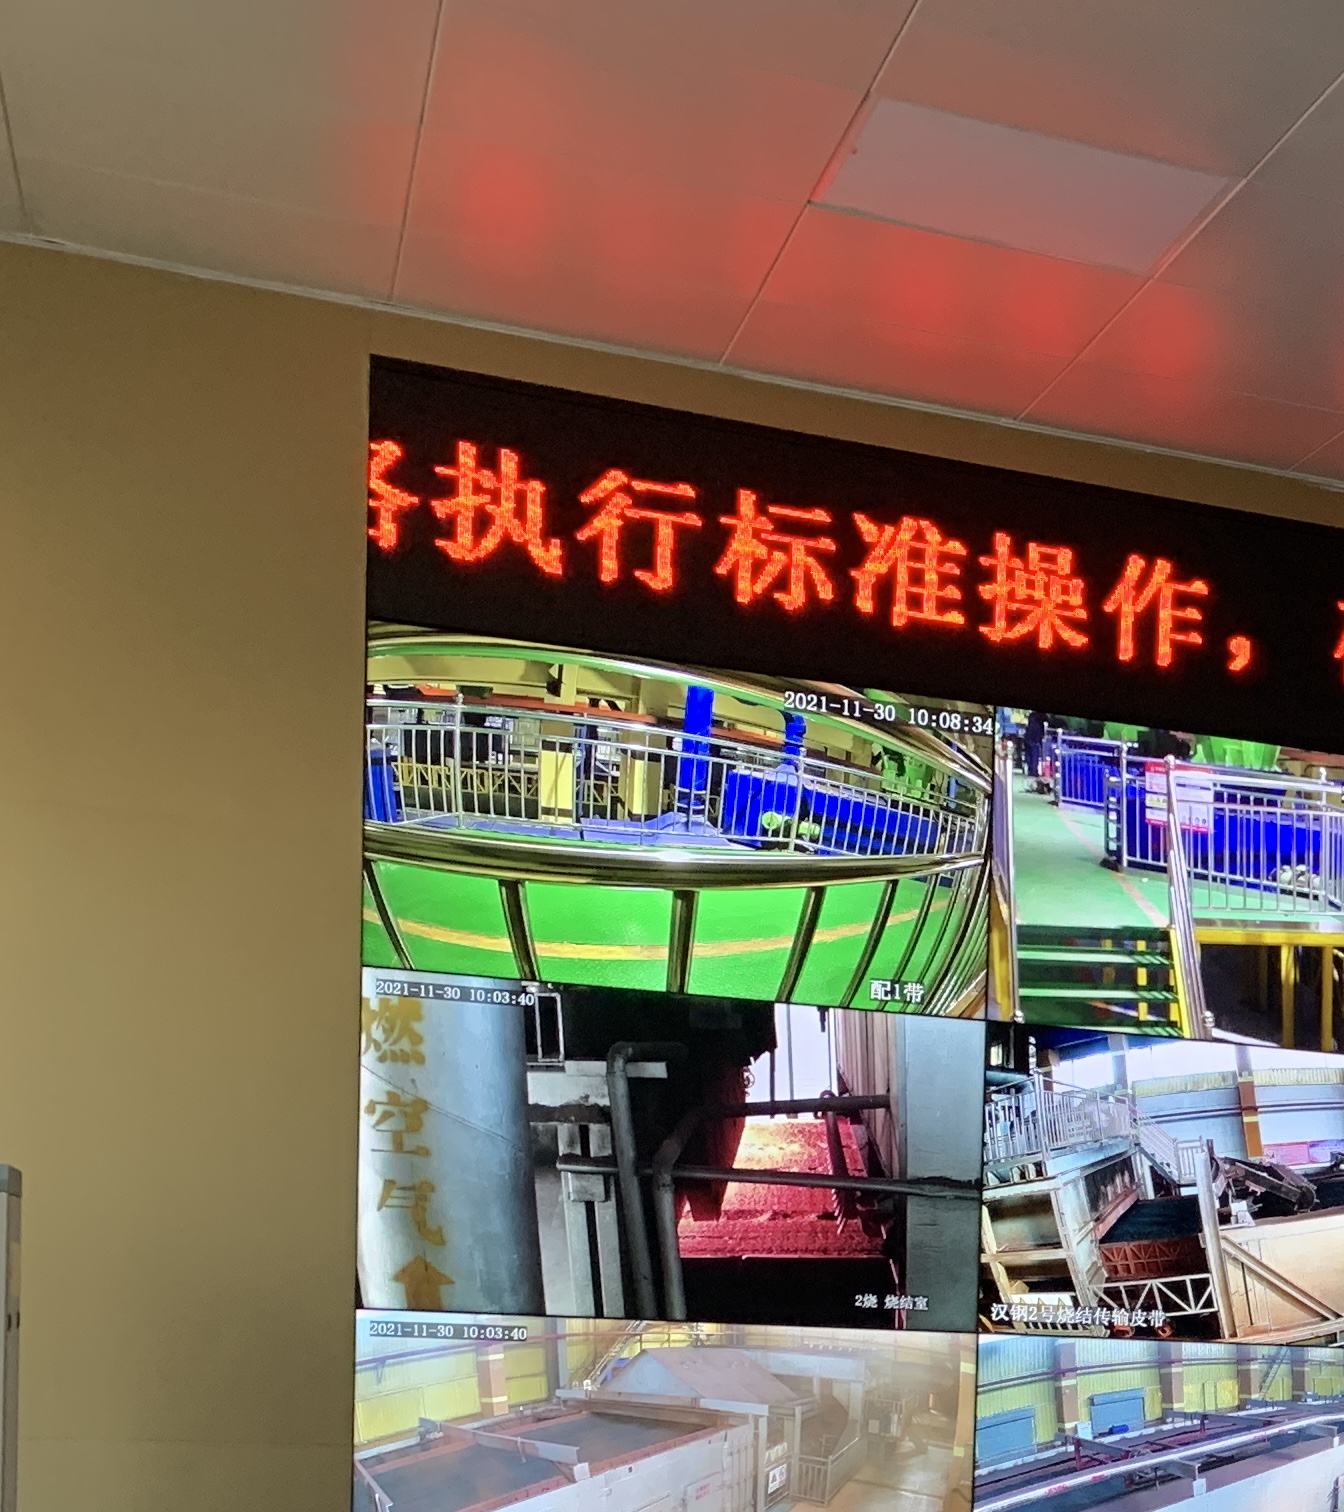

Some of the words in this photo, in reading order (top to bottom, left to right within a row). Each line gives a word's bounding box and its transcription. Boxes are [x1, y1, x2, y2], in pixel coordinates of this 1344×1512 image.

[783, 690, 896, 722] 2021-11-30
[907, 707, 994, 736] 10:08:34
[375, 978, 462, 1001] 2021-11-30
[468, 988, 535, 1007] 10:03:40
[870, 978, 925, 1003] 配1带
[990, 1303, 1166, 1327] 汉钢2号烧结传输皮带
[369, 1321, 454, 1339] 2021-11-30
[462, 1325, 528, 1341] 10:03:40
